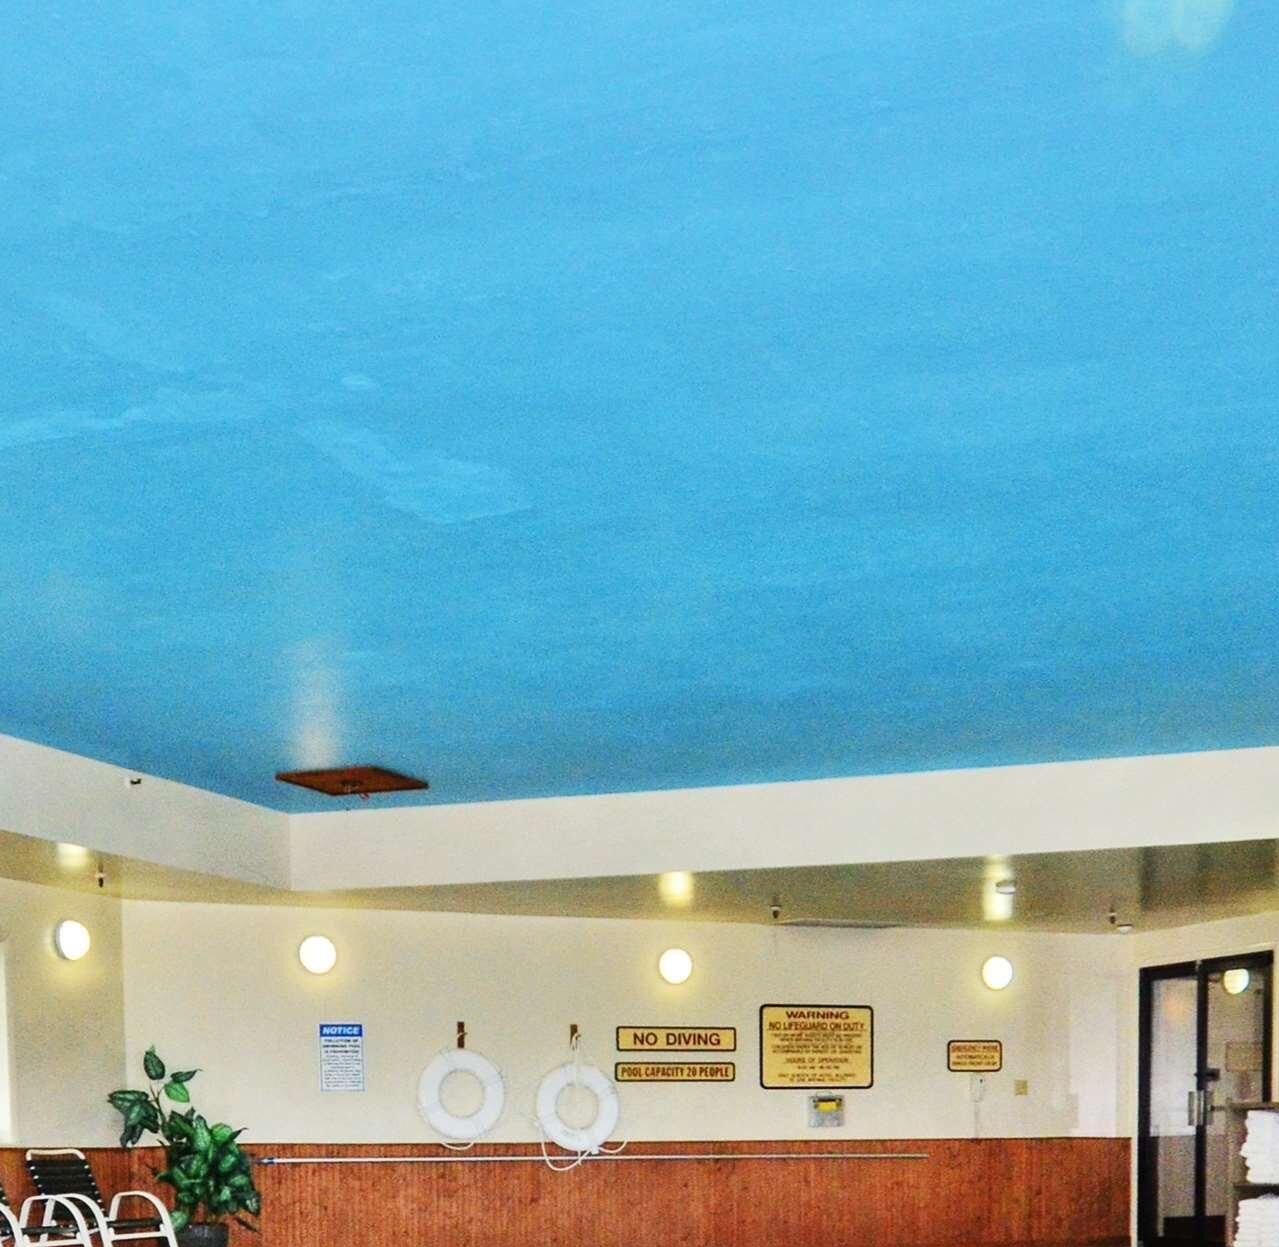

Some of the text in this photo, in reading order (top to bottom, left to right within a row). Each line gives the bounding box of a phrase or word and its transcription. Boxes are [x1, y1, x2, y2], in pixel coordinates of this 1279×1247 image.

[785, 1010, 850, 1020] WARNING
[322, 1026, 360, 1035] NOTICE
[768, 1021, 865, 1031] NO LIFEGUARD ON DUTY
[632, 1032, 721, 1046] NO DIVING
[621, 1066, 642, 1078] POOL
[644, 1066, 684, 1078] CAPACITY
[699, 1066, 729, 1078] PEOPLE
